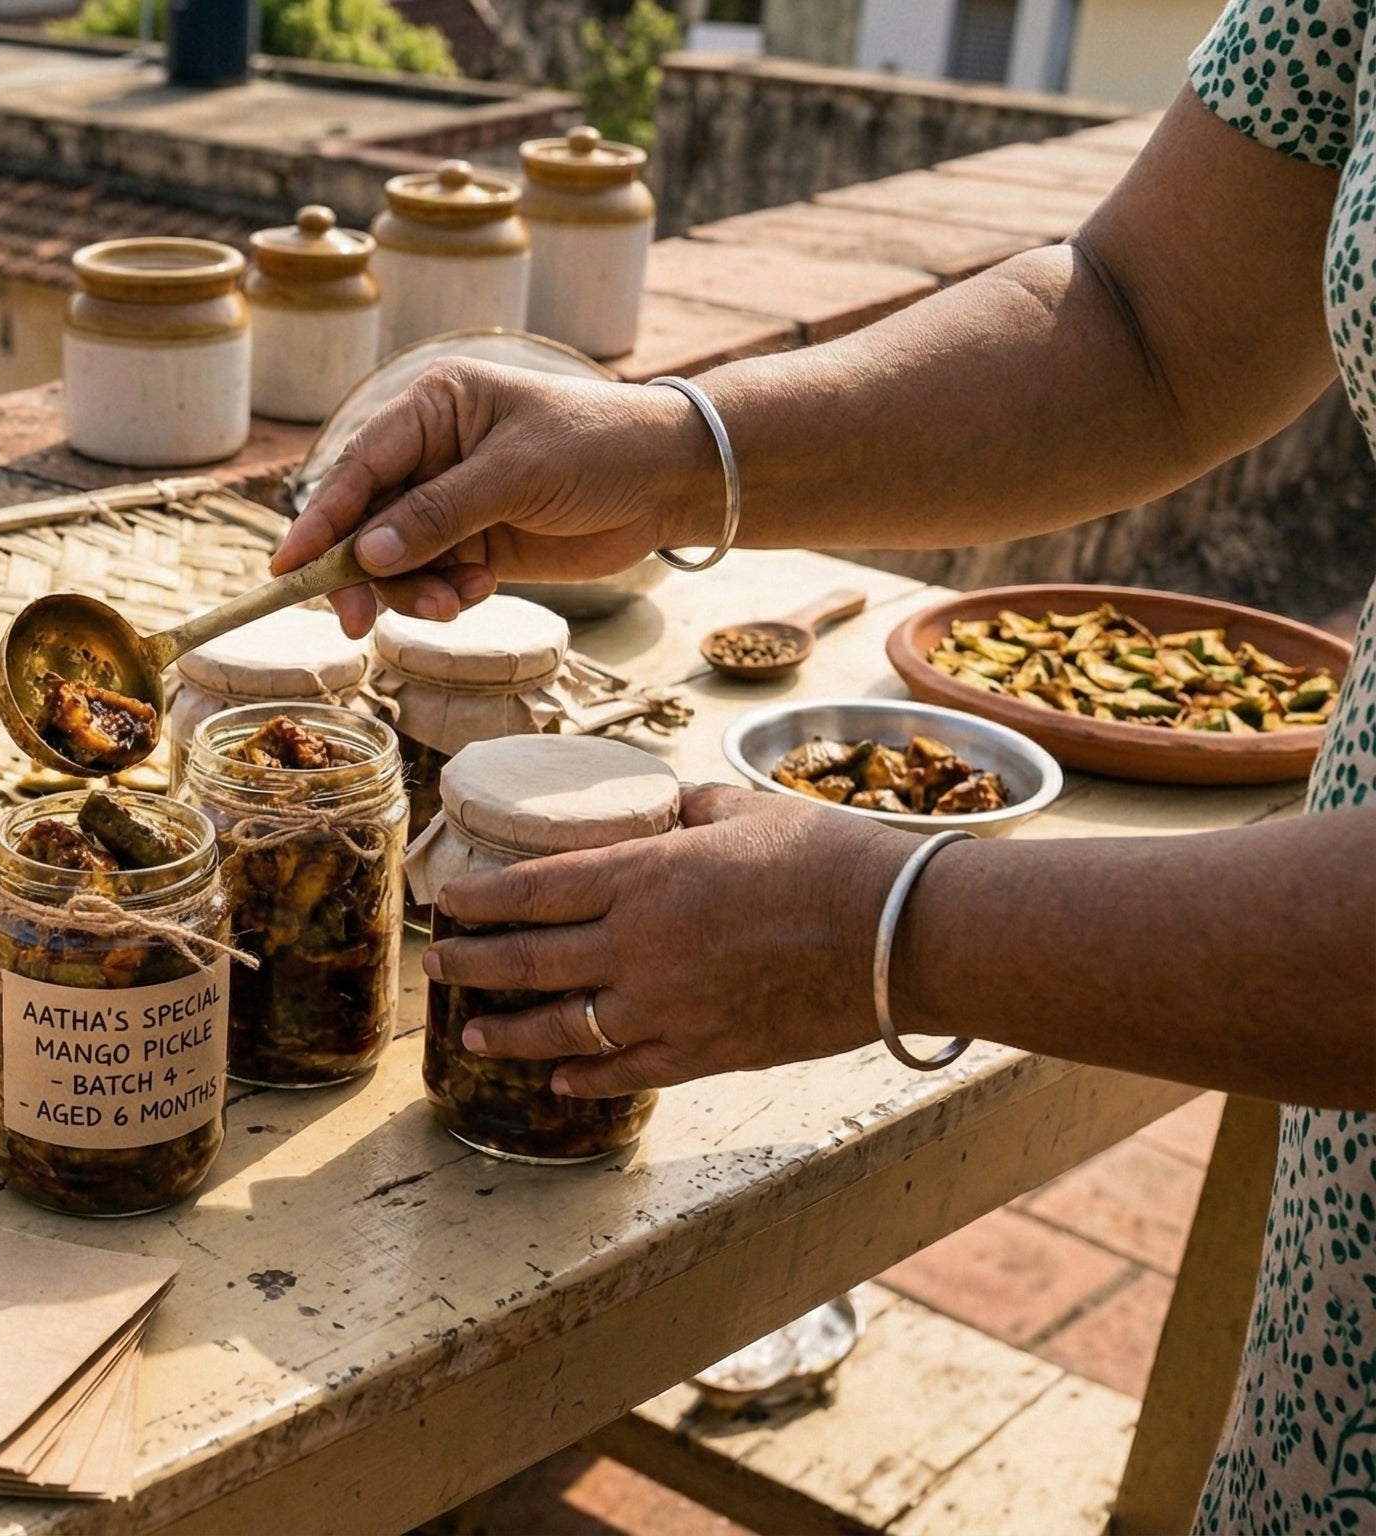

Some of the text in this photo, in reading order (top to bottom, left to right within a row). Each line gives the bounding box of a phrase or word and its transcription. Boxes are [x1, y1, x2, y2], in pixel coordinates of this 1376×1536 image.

[23, 983, 220, 1032] AATHA'S SPECIAL
[35, 1018, 212, 1066] MANGO PICKLE
[37, 1100, 102, 1127] AGED
[113, 1106, 128, 1126] 6
[140, 1076, 217, 1123] MONTHS
[73, 1070, 152, 1096] BATCH
[163, 1067, 177, 1085] 4
